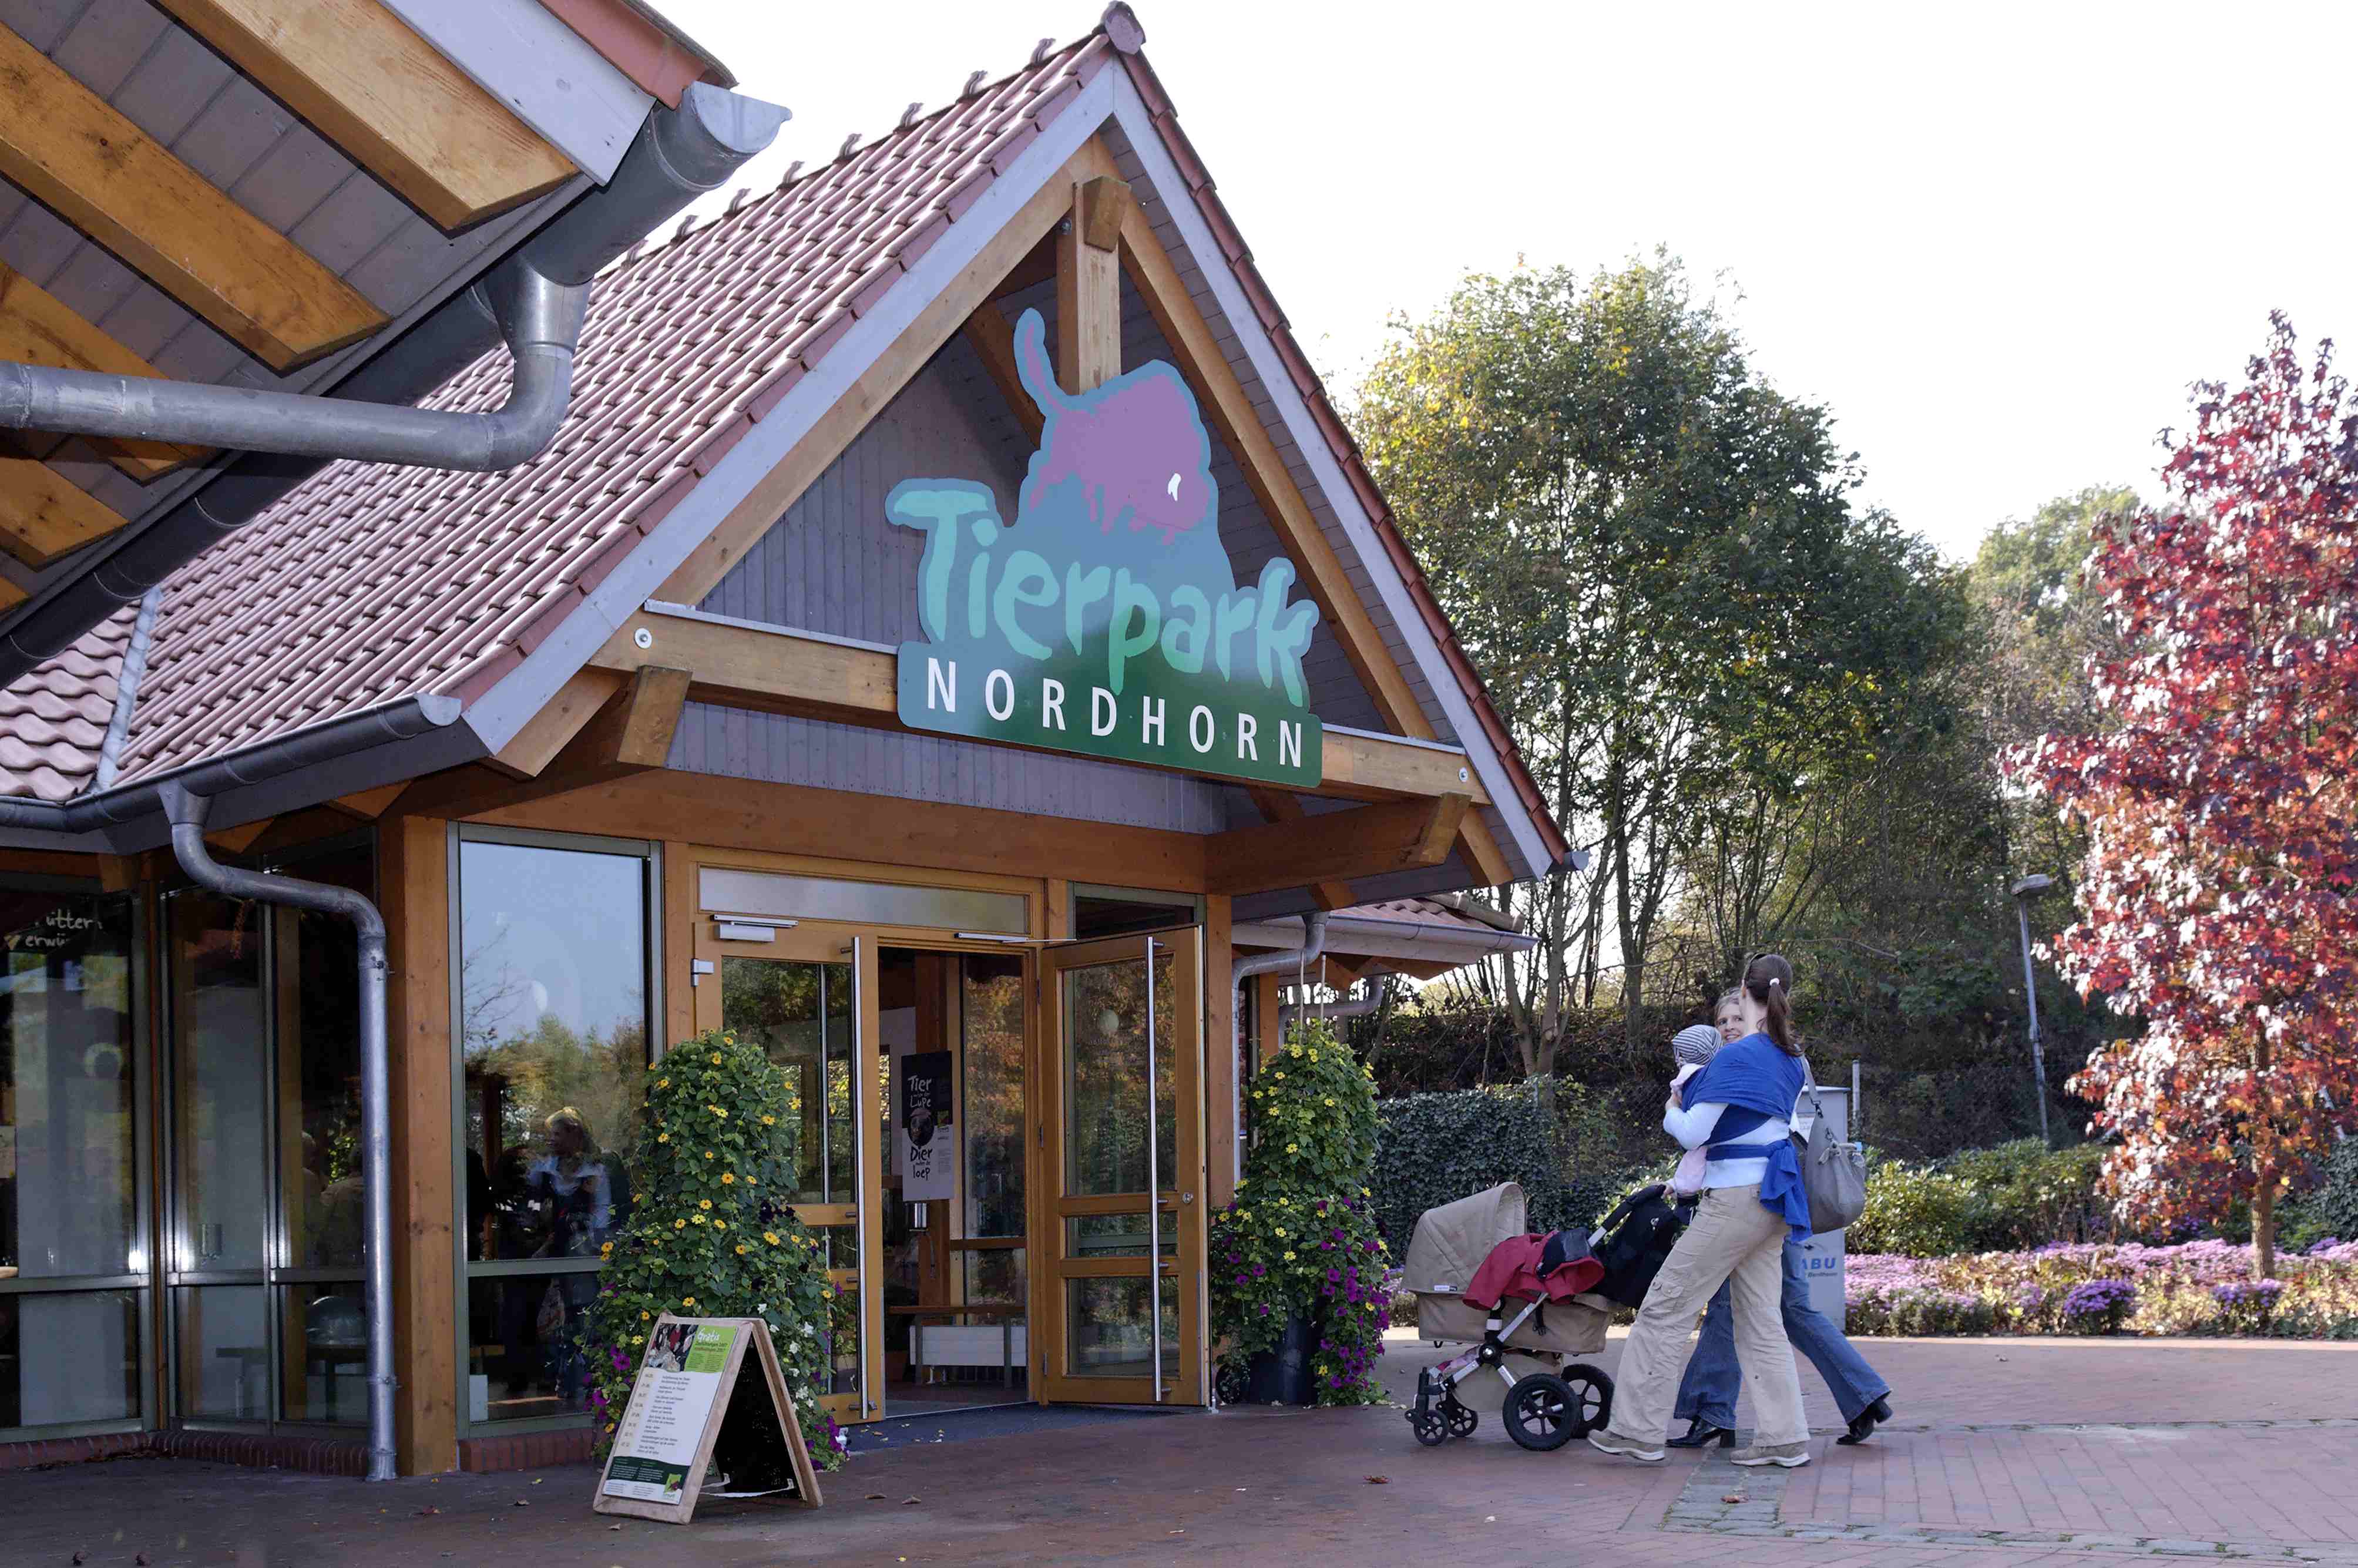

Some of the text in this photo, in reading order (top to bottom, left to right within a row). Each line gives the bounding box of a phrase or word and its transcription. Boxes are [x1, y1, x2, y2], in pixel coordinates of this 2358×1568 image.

[894, 490, 1313, 707] Tierpark
[927, 657, 1302, 768] NORDHORN
[908, 1075, 932, 1092] Tier
[911, 1146, 933, 1161] Dier
